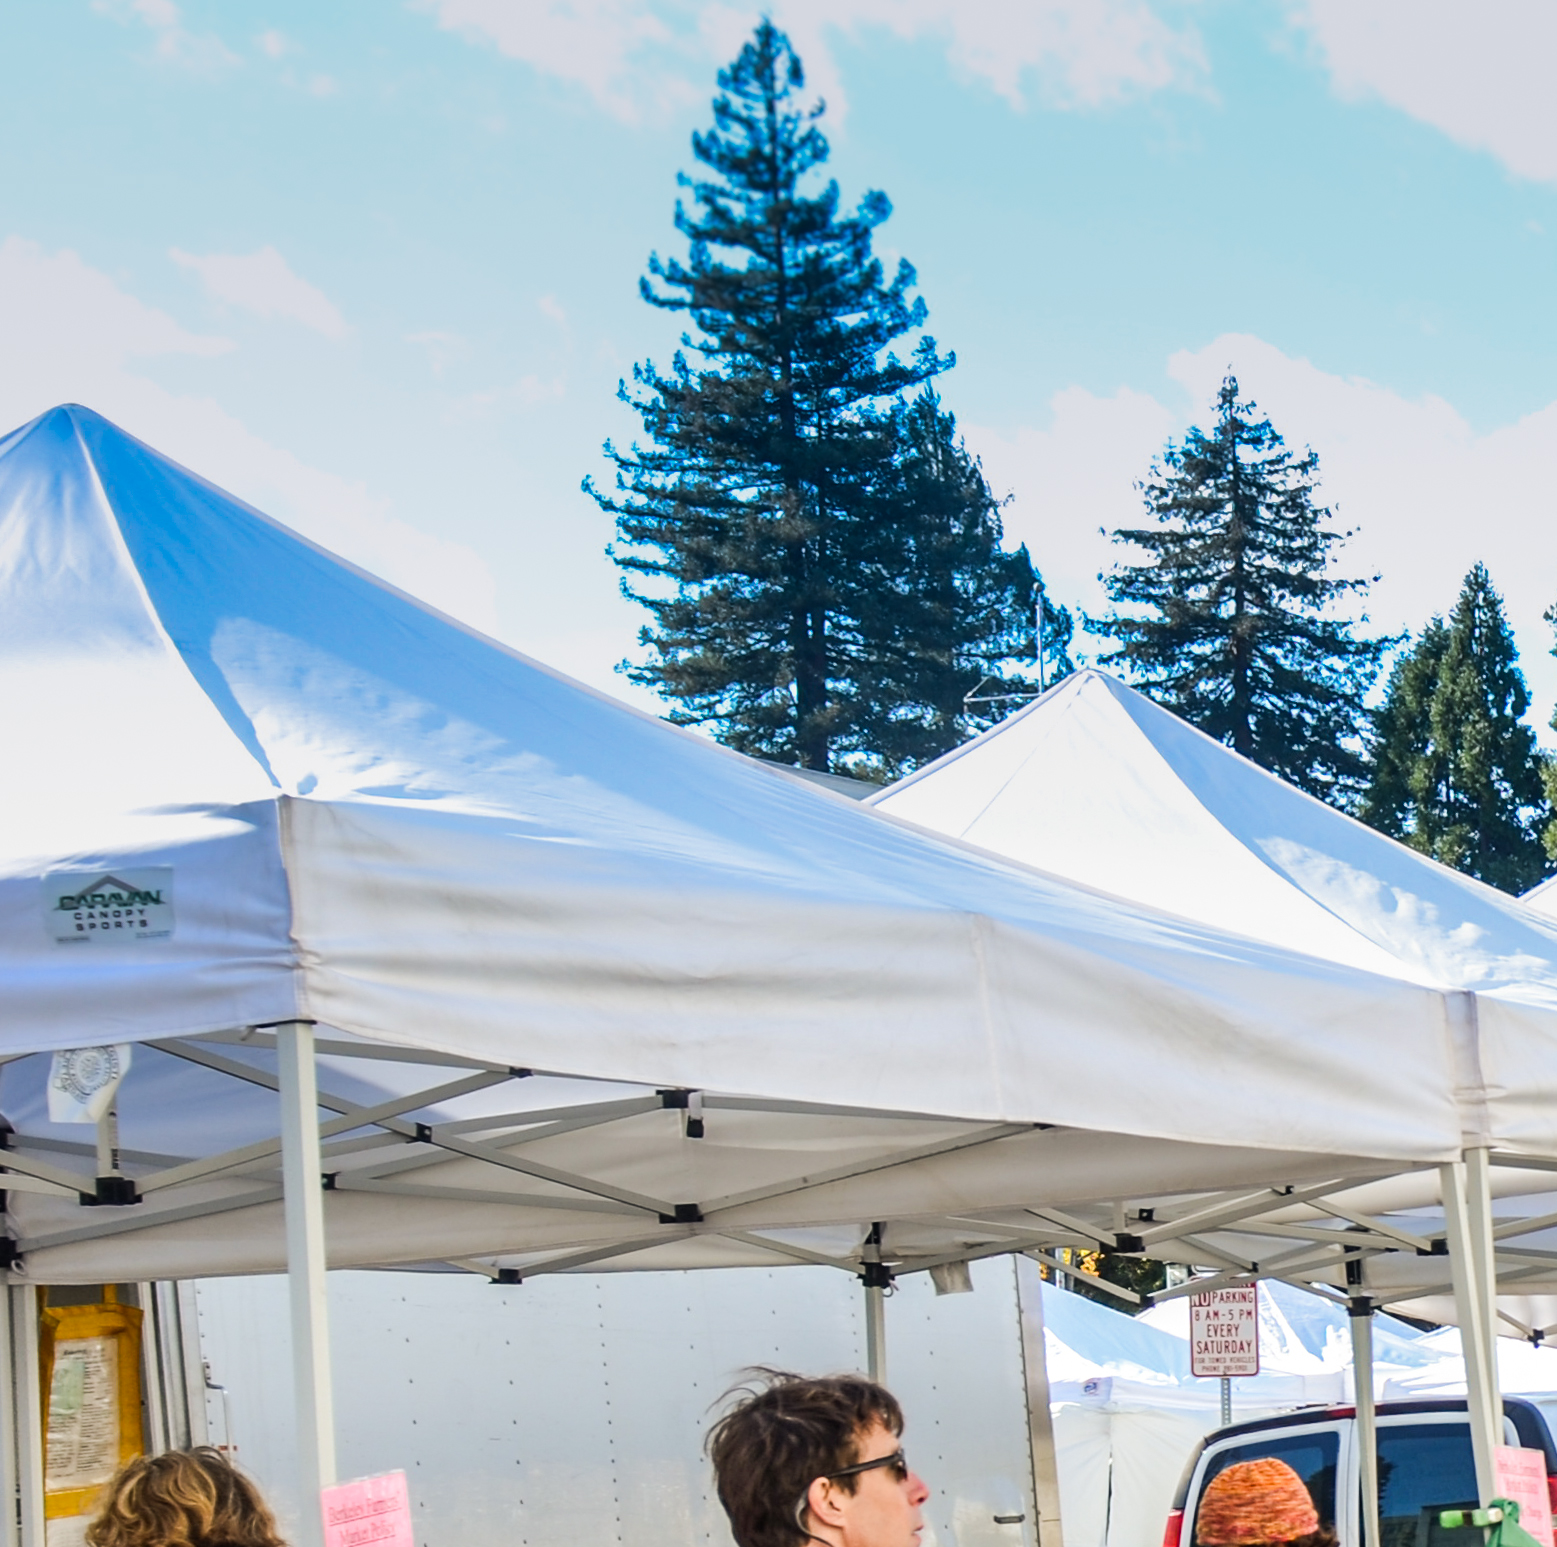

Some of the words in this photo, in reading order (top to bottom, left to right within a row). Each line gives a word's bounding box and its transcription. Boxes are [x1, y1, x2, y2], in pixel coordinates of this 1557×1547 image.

[58, 889, 164, 911] CARAVAN
[74, 909, 145, 921] CANOPY
[75, 919, 148, 932] SPORTS
[1212, 1291, 1254, 1304] PARKING
[1194, 1310, 1200, 1322] 8
[1239, 1309, 1253, 1321] PM
[1206, 1323, 1240, 1338] EVERY
[1196, 1340, 1253, 1355] SATURDAY
